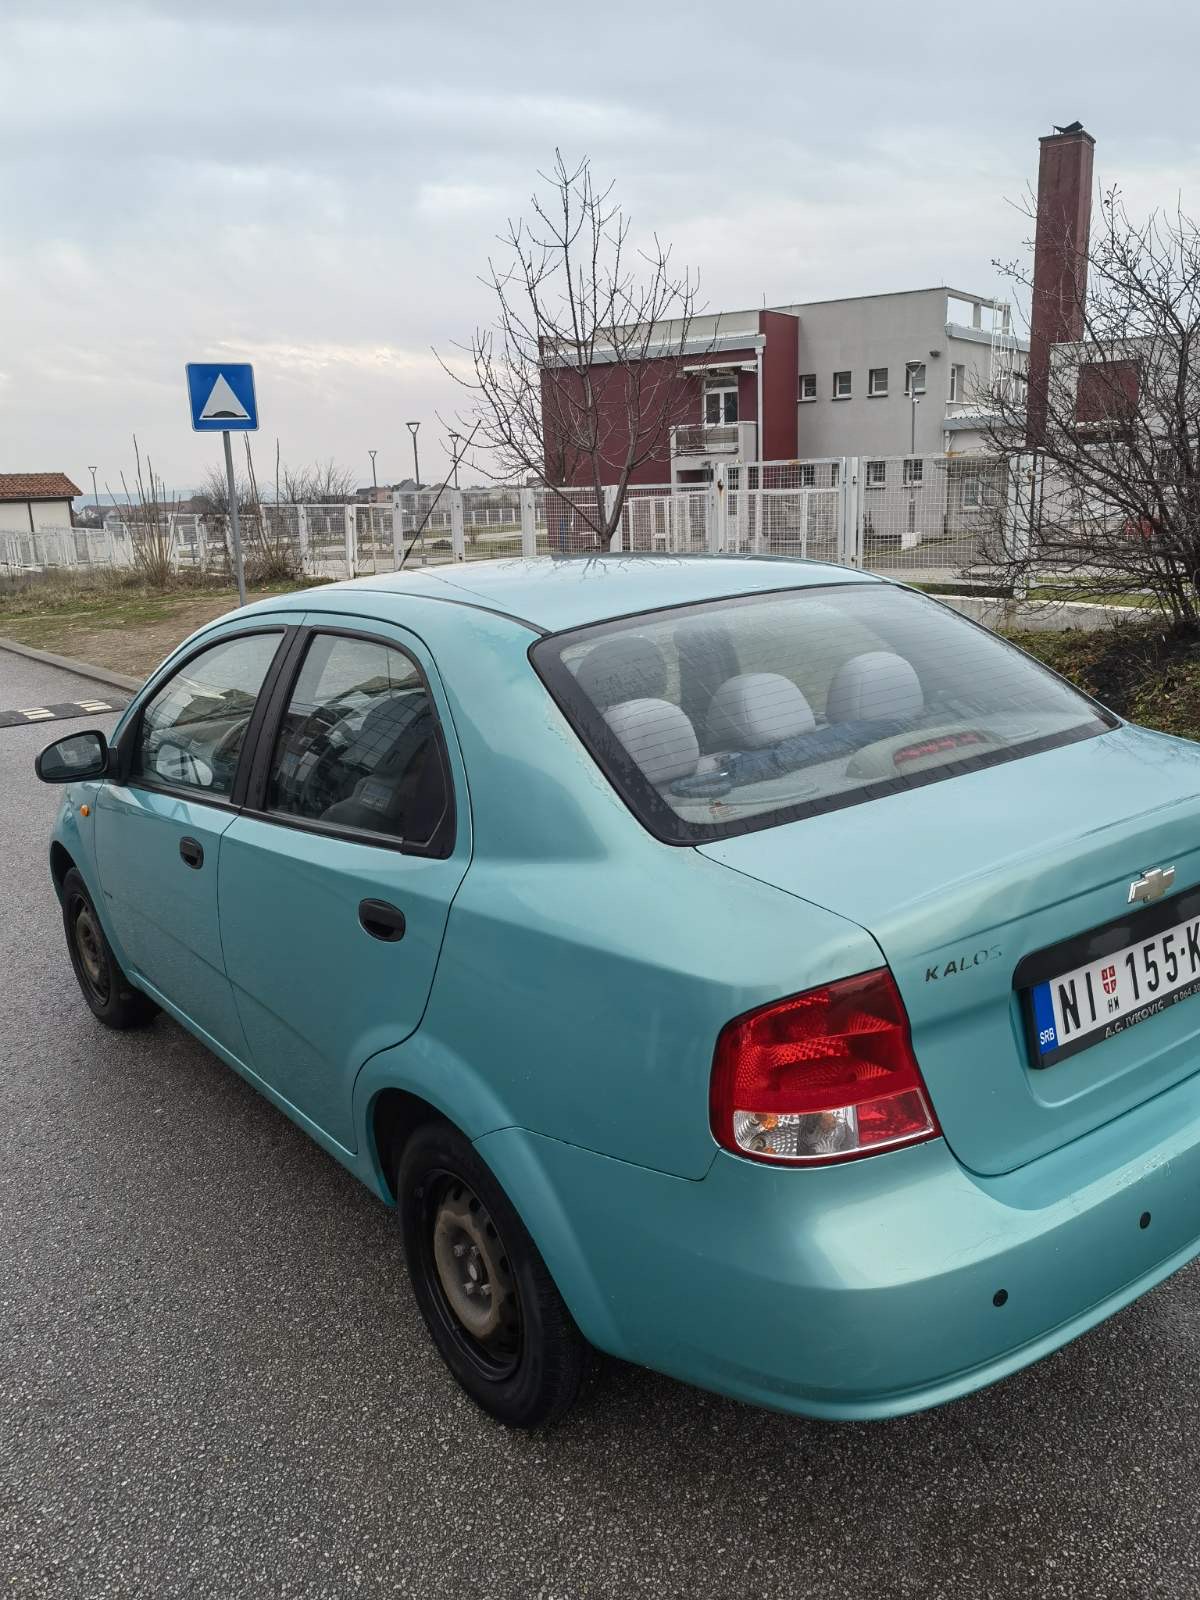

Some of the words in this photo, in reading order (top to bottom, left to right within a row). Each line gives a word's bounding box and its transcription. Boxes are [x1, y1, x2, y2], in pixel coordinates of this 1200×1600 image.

[925, 944, 1002, 983] KALOS
[1058, 972, 1097, 1035] NI
[1040, 1027, 1055, 1045] SRB
